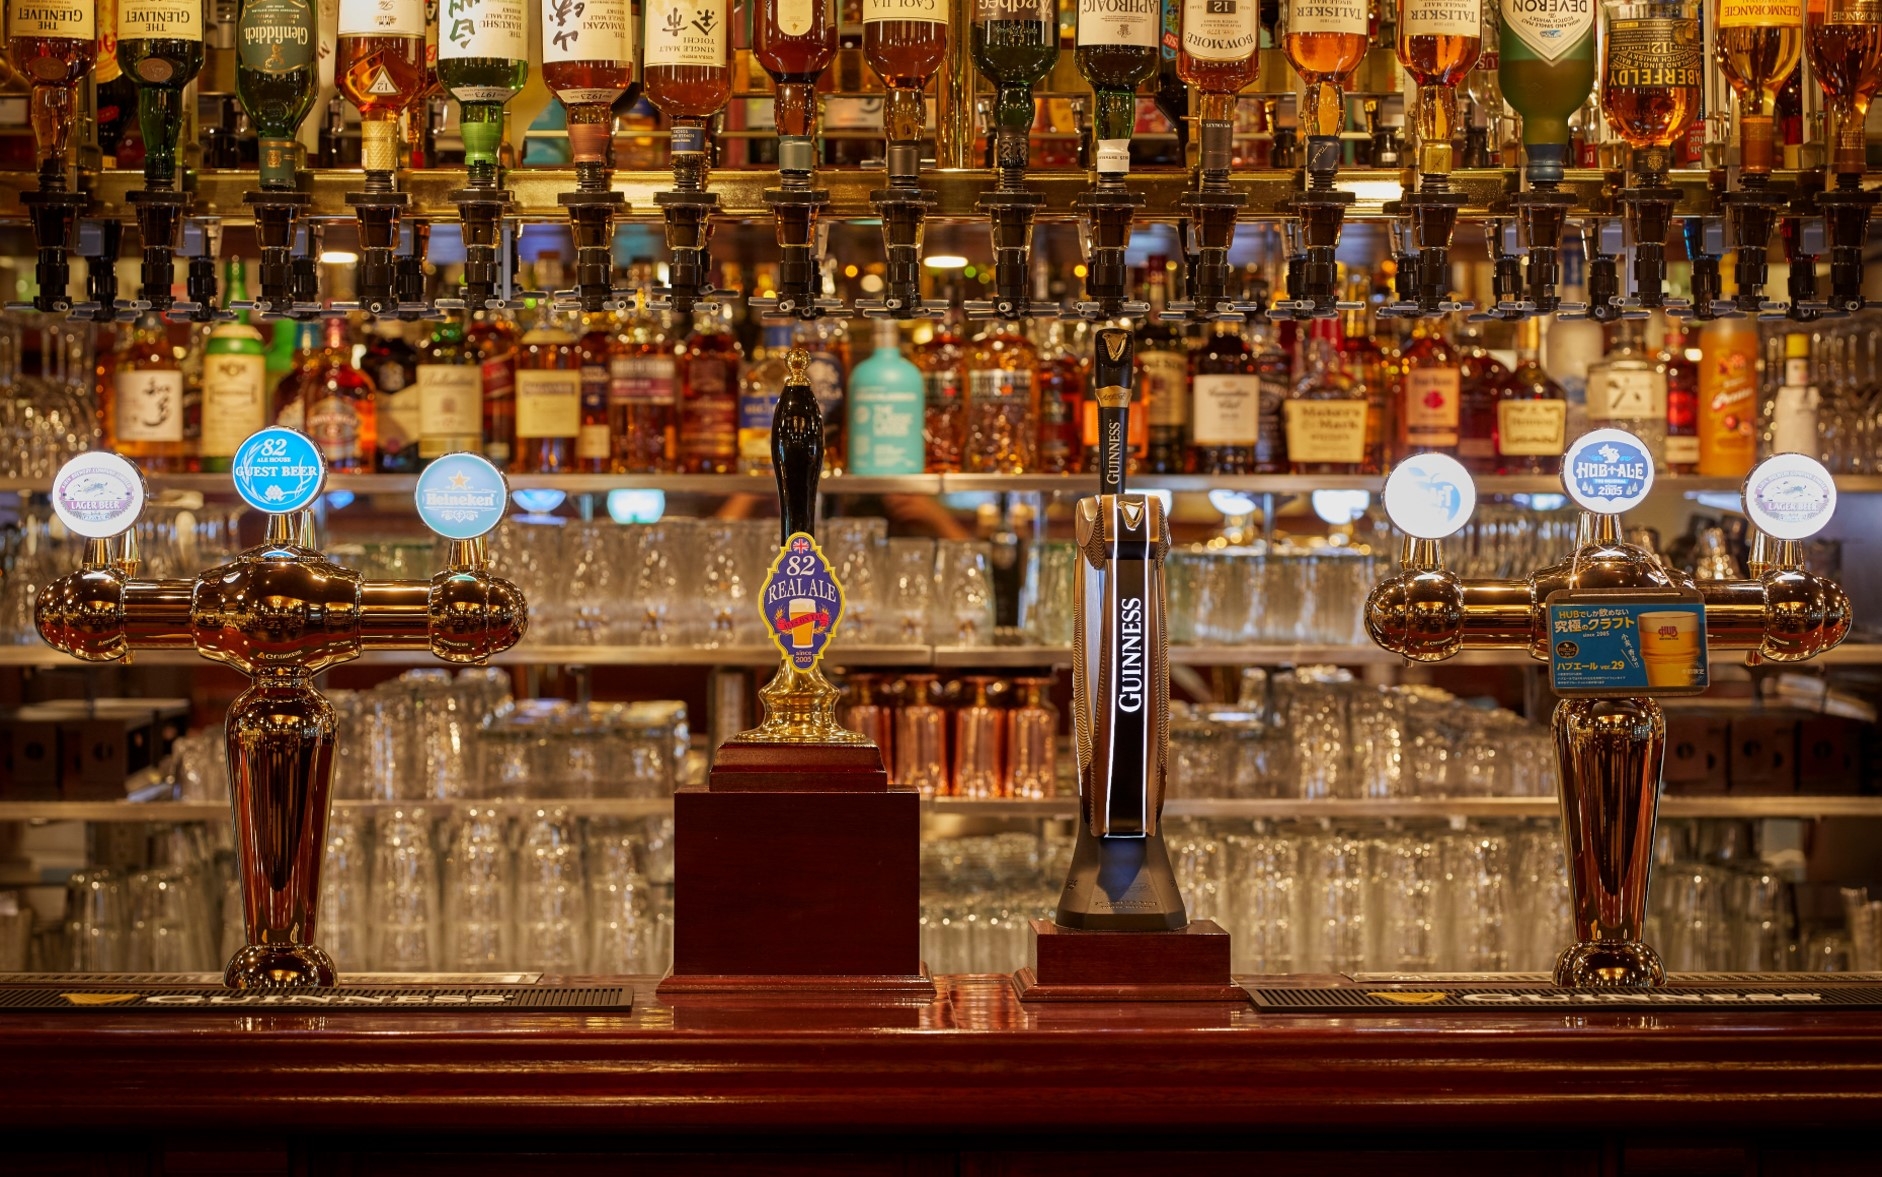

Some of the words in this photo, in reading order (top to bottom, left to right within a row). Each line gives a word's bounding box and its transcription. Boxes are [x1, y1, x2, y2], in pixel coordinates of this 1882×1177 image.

[1213, 1, 1229, 12] 12
[1513, 0, 1587, 13] DEVERON
[1724, 5, 1800, 17] GLENMORANGIE
[18, 8, 82, 22] GLENLIVET
[125, 10, 190, 23] GLENLIVET
[1297, 7, 1362, 20] TALISKER
[1410, 10, 1477, 23] TALISKER
[38, 21, 58, 30] THE
[146, 23, 166, 32] THE
[583, 21, 626, 30] YAMAZAKI
[245, 26, 308, 45] Glenfiddich
[683, 36, 715, 44] YOICHI
[1186, 31, 1254, 50] BOWMORE
[659, 45, 681, 53] MALT
[683, 45, 715, 53] SINGLE
[1651, 42, 1670, 54] 12
[1615, 55, 1632, 65] MALT
[1627, 52, 1659, 62] WHISKY
[1661, 52, 1689, 62] SCOTCH
[1633, 61, 1664, 69] SINGLE
[1608, 68, 1701, 87] ABERFELDY
[377, 82, 389, 91] 12
[581, 92, 602, 100] 1923
[261, 438, 288, 457] 82
[1106, 421, 1121, 485] GUINNESS
[235, 466, 279, 477] GUEST
[281, 465, 318, 477] BEER
[71, 500, 98, 510] LAGER
[99, 500, 120, 510] BEER
[426, 493, 494, 506] Heineken
[786, 555, 816, 576] 82
[768, 578, 807, 605] REAL
[808, 578, 837, 603] ALE
[1558, 608, 1630, 619] HUBでしか飲めない
[1554, 617, 1635, 634] 究極のクラフト
[1118, 597, 1142, 713] GUINNESS
[1556, 661, 1599, 671] ハブエール
[145, 994, 512, 1004] GUINNESS
